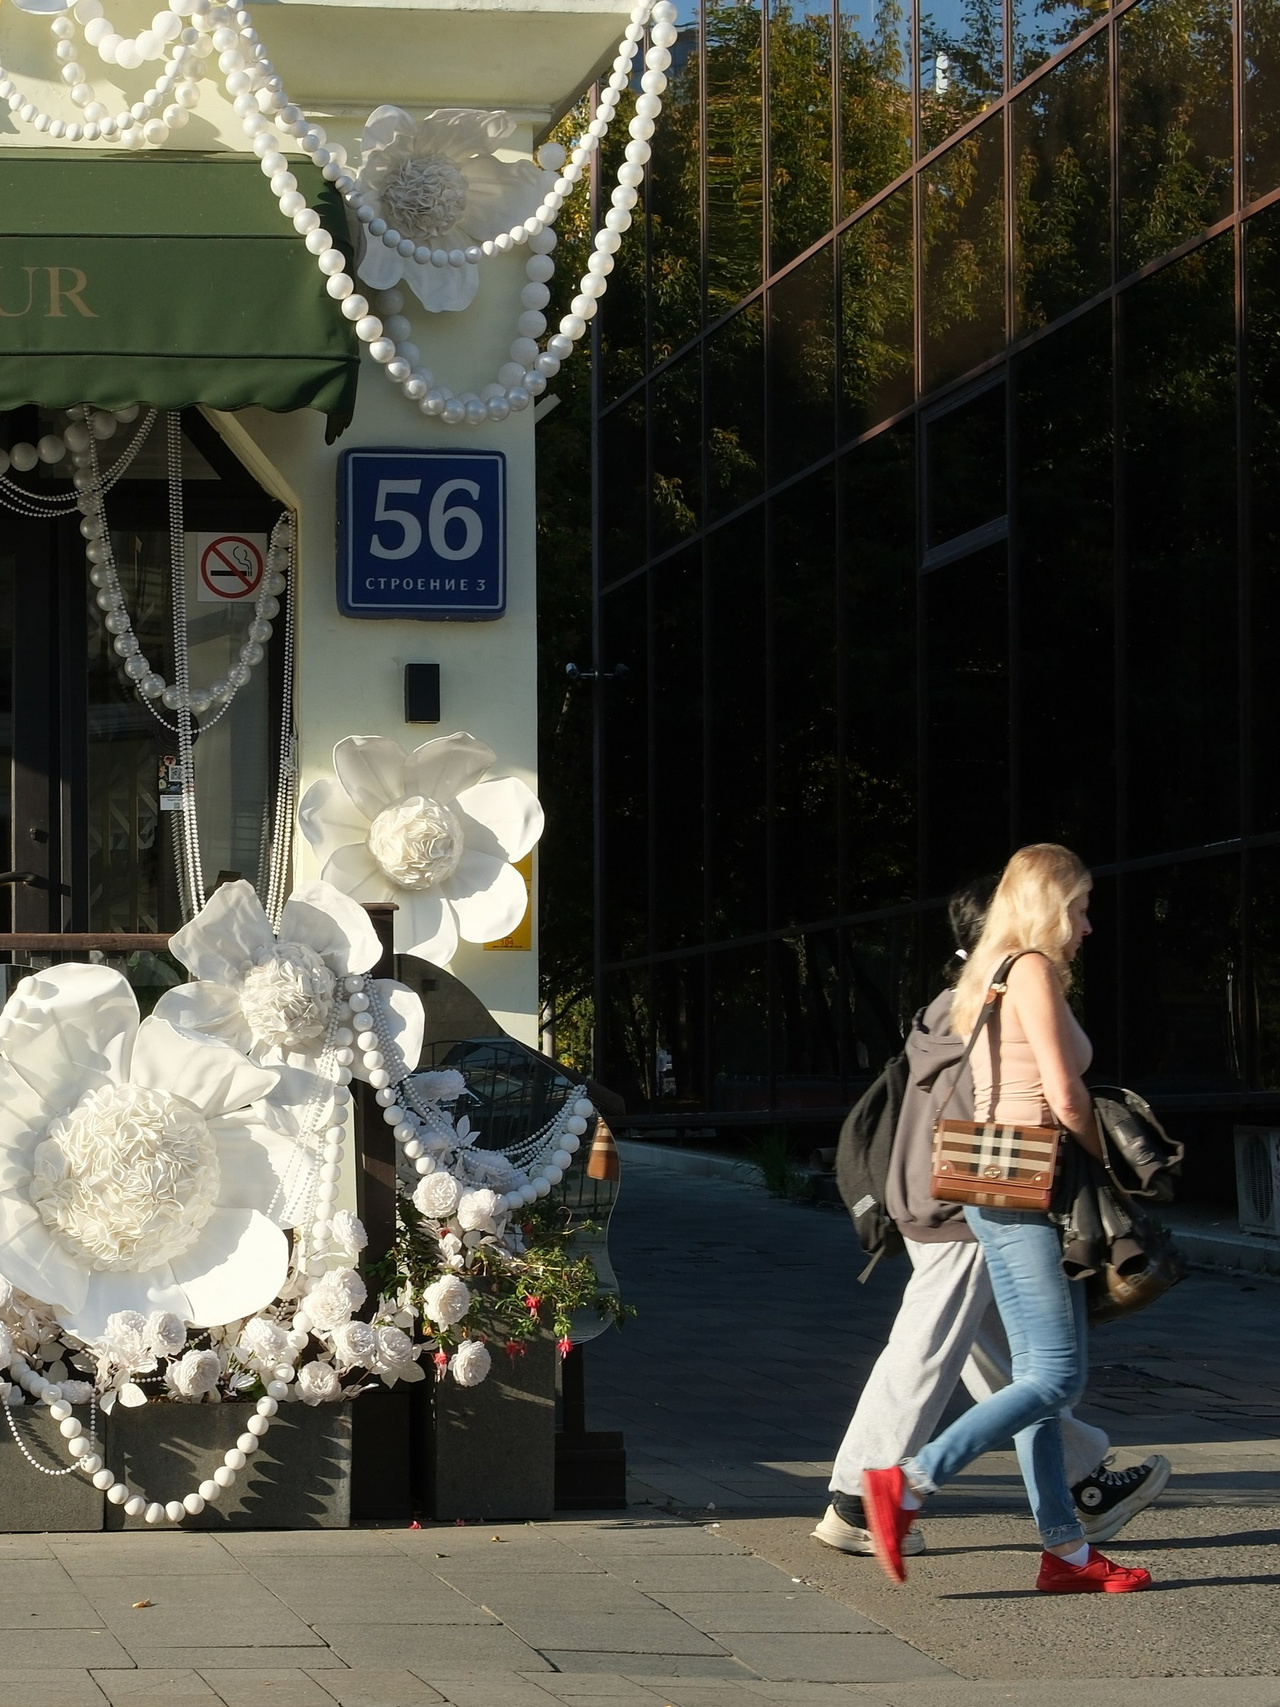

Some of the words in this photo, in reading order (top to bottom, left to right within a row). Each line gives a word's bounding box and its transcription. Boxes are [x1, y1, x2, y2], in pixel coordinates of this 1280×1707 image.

[369, 478, 483, 561] 56
[365, 577, 469, 591] СТРОЕНИЕ
[476, 579, 486, 591] 3
